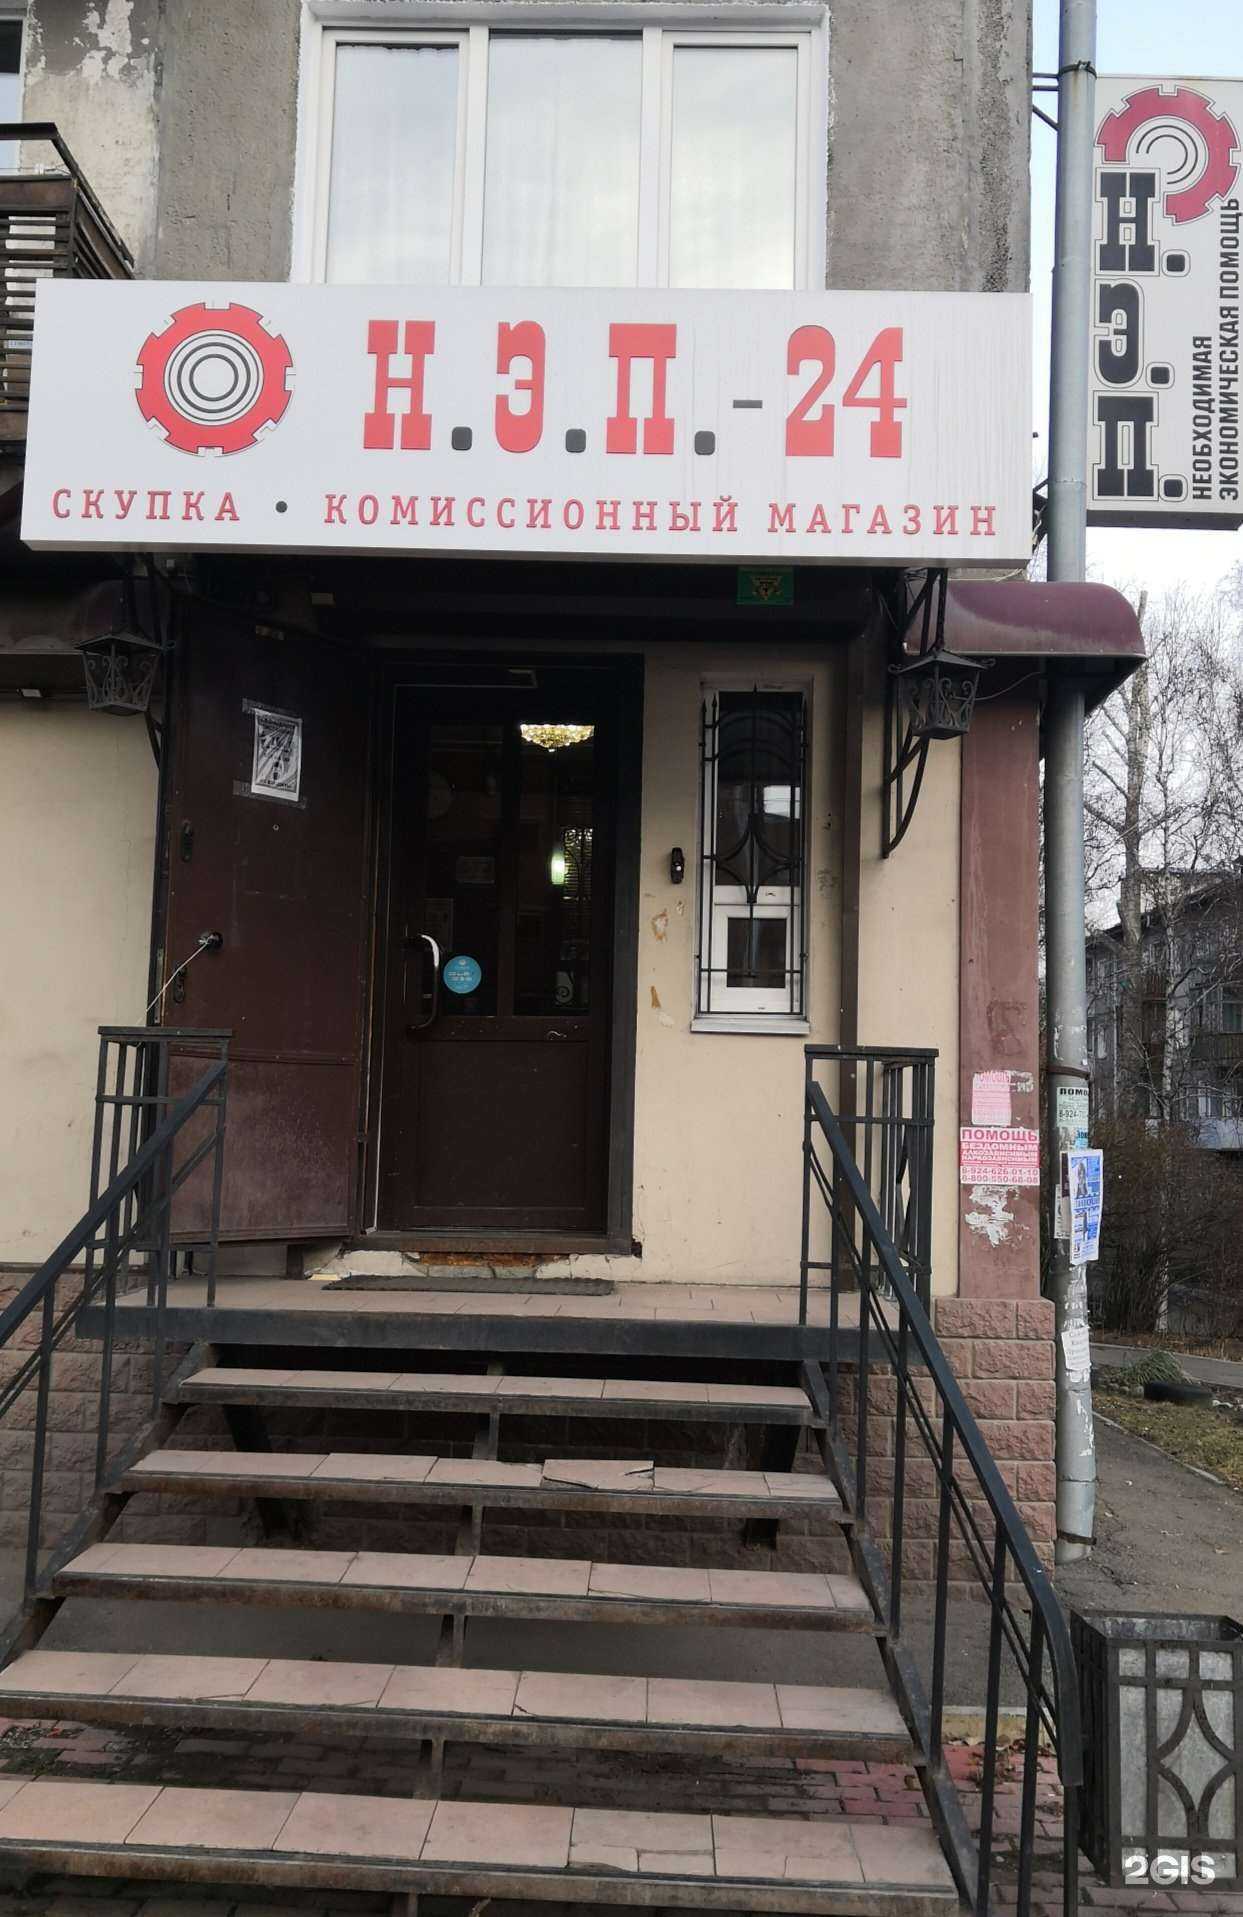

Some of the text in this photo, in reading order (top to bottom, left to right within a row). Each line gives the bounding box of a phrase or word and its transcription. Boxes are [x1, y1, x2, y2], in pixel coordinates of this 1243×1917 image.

[1219, 199, 1243, 501] ЭКОНОМИЧЕСКАЯ ПОМОЩЬ
[1192, 336, 1215, 500] НЕОБХОДИМАЯ
[52, 488, 996, 536] СКУПКА КОМИССИОННЫЙ МАГАЗИН
[962, 1129, 1038, 1142] ПОМОЩЬ
